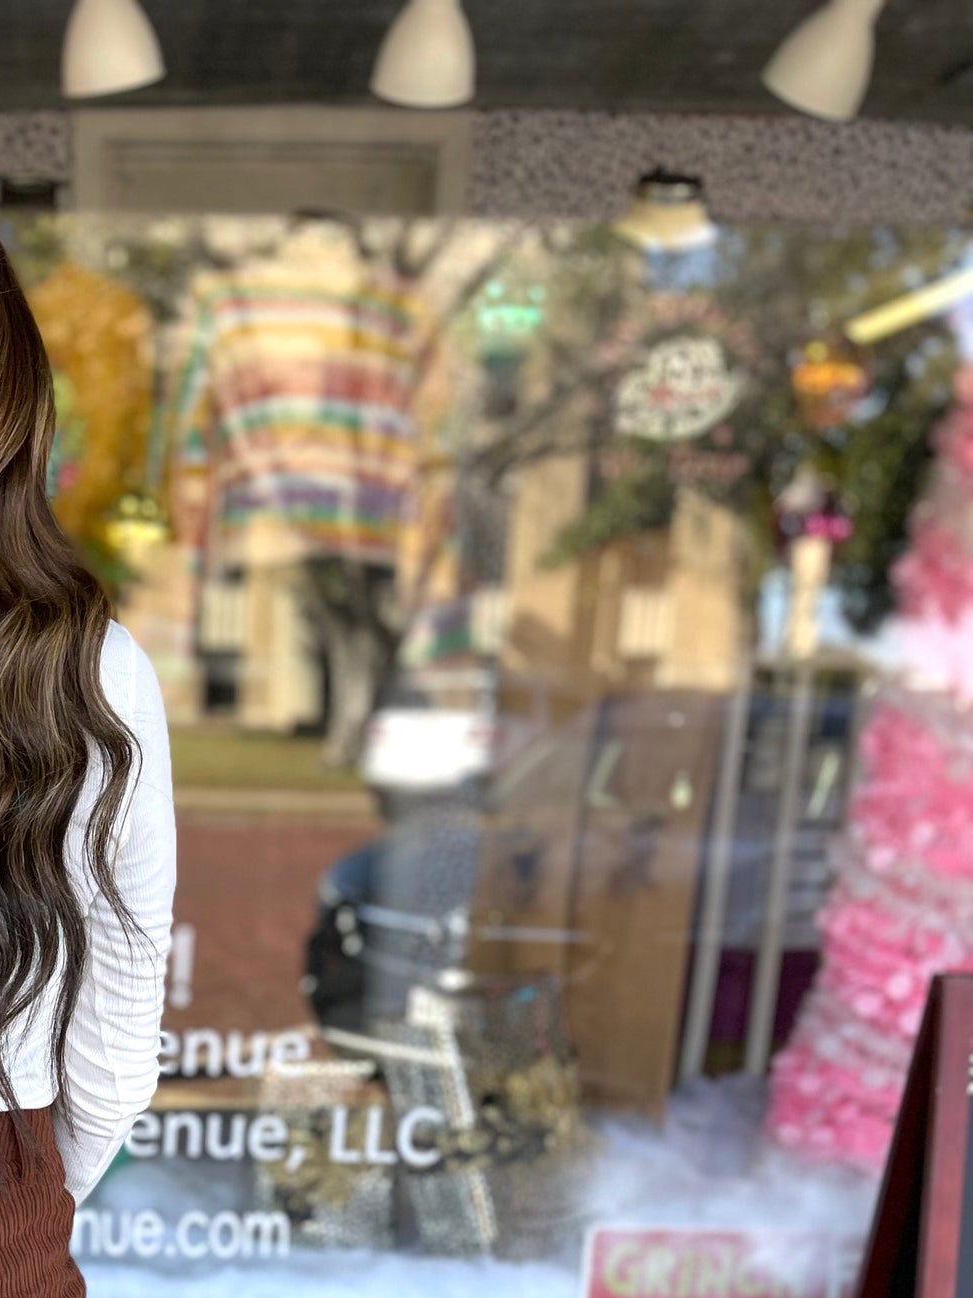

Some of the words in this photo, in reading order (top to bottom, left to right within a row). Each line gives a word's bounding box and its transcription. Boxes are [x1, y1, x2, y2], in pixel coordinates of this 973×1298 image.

[159, 1028, 311, 1077] enue
[125, 1110, 305, 1173] enue,
[329, 1105, 444, 1167] LLC
[70, 1209, 291, 1258] nue.com
